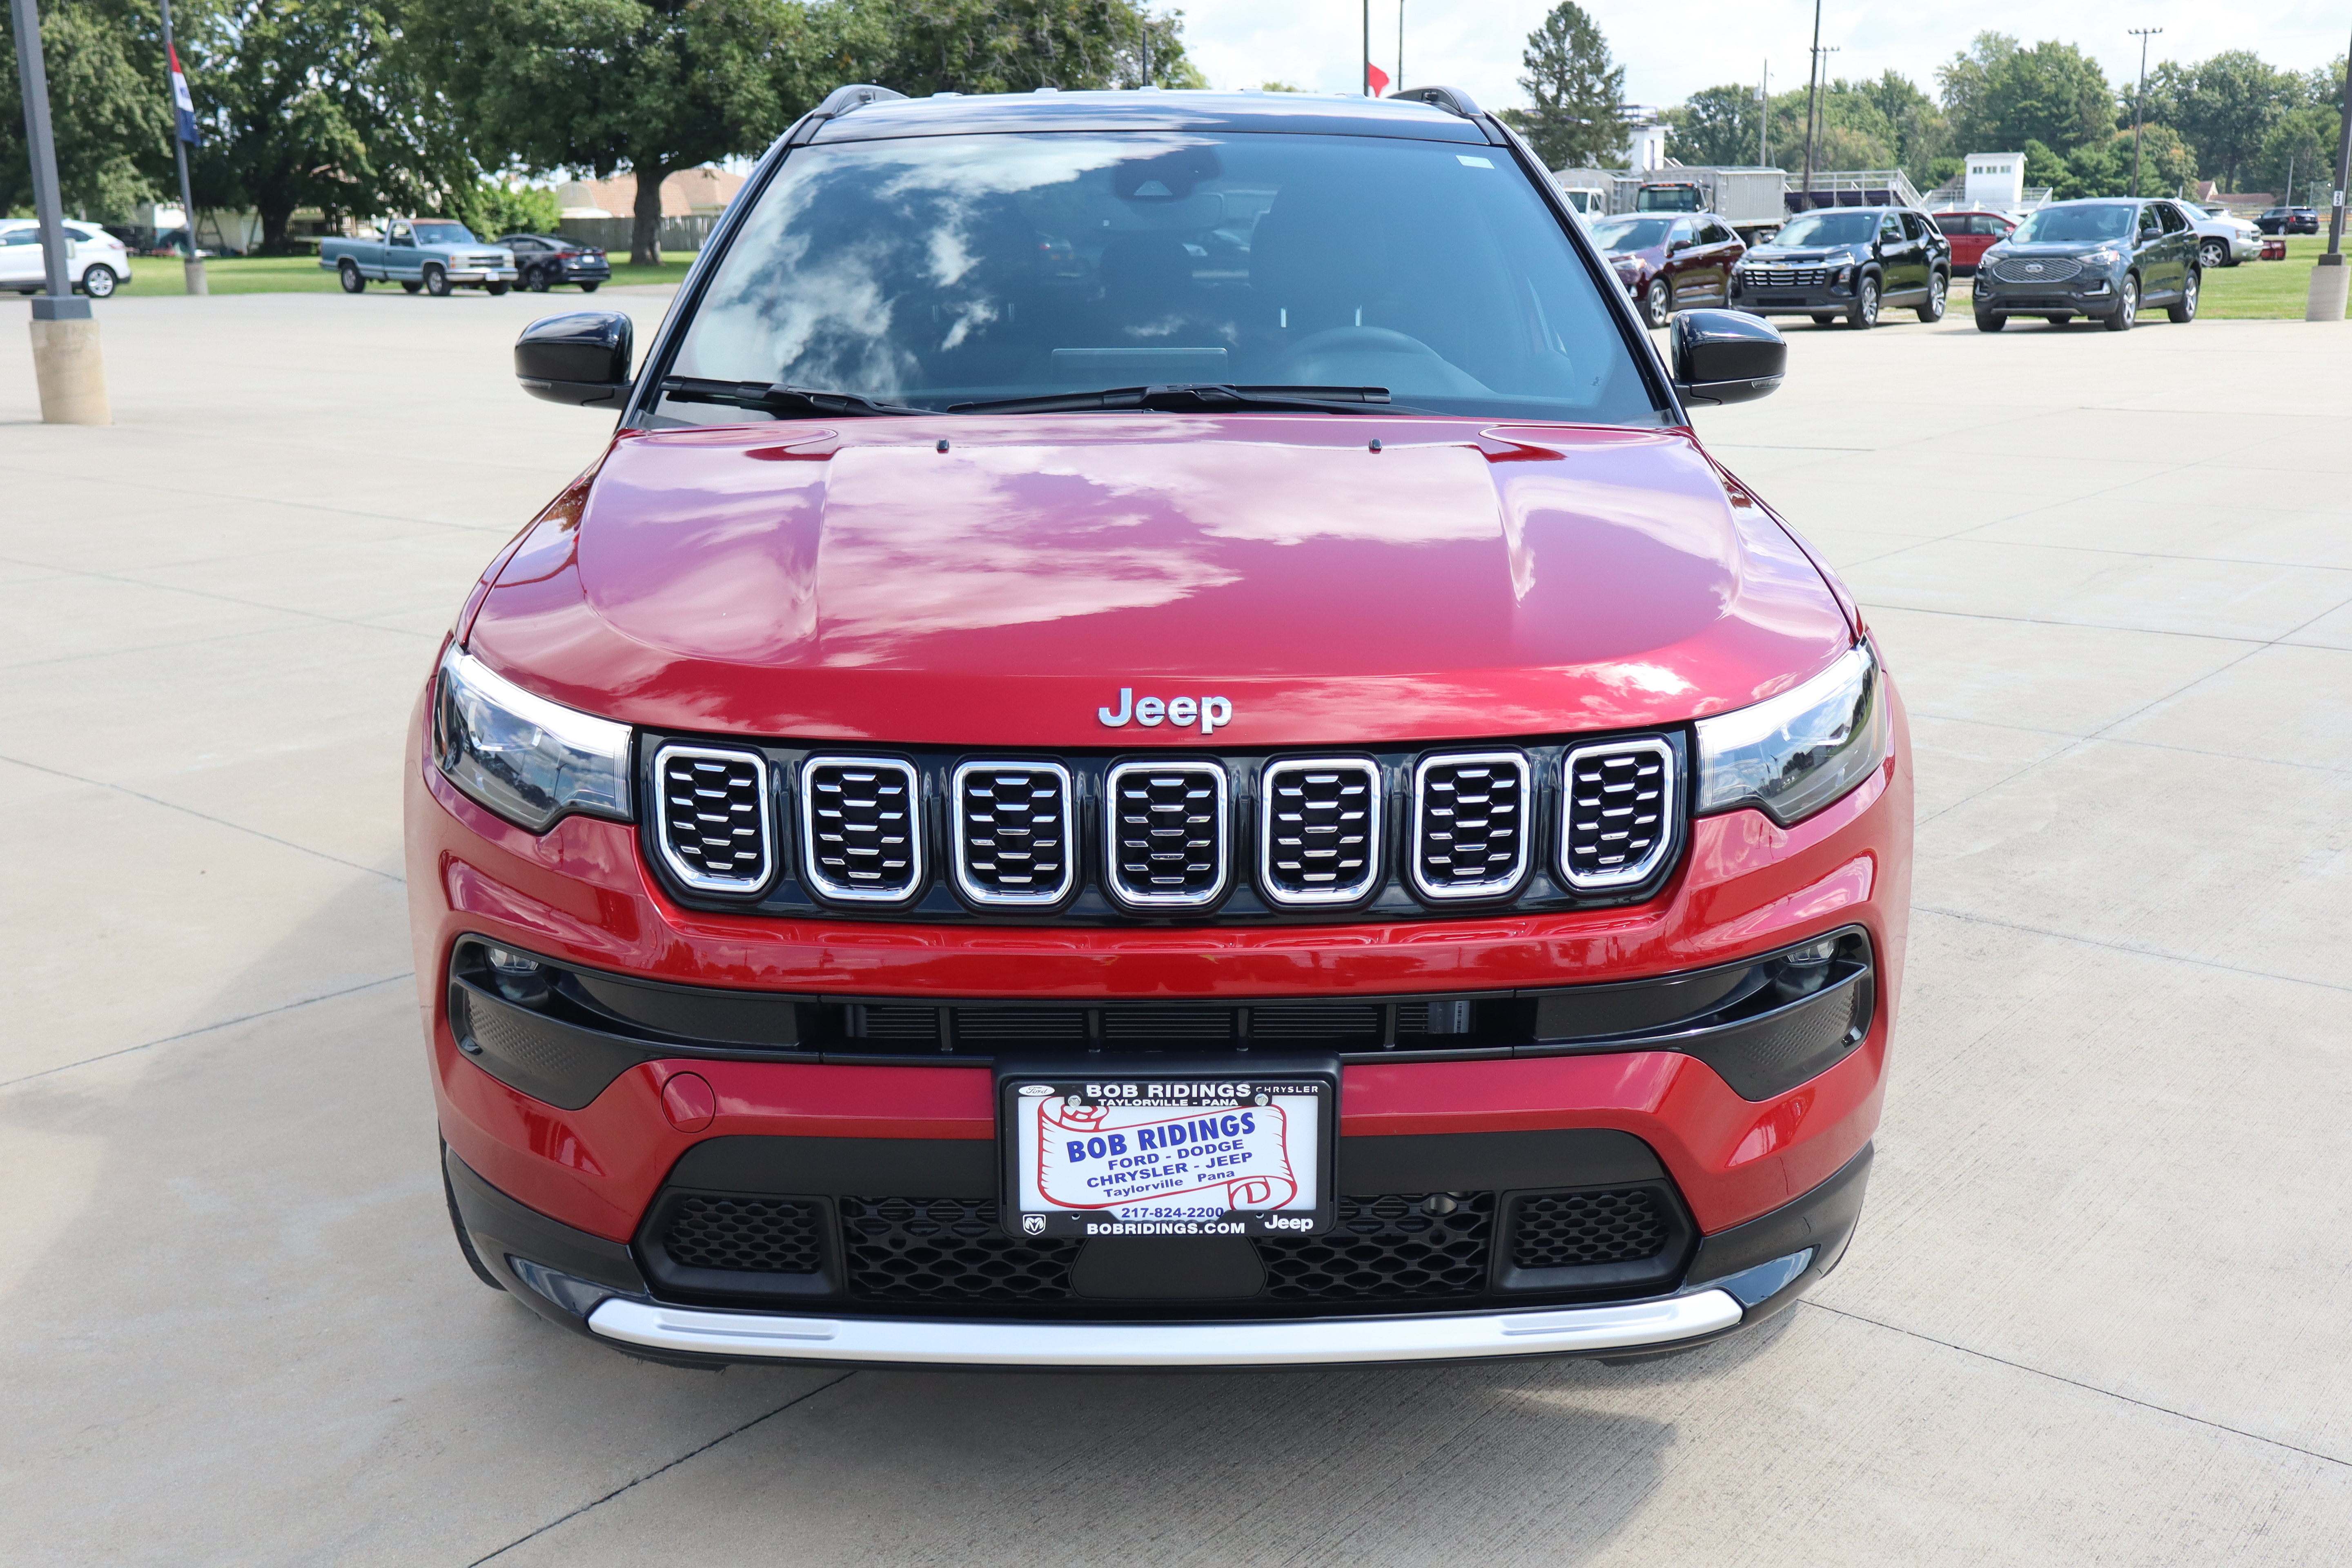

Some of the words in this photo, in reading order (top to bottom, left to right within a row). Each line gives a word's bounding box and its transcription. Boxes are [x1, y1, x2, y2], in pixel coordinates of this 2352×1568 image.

[1098, 688, 1232, 734] Jeep
[1087, 1084, 1138, 1098] BOB
[1148, 1084, 1251, 1098] RIDINGS
[1066, 1134, 1127, 1163] BOB
[1137, 1112, 1256, 1151] RIDINGS
[1108, 1153, 1160, 1171] FORD
[1177, 1139, 1244, 1159] DODGE
[1087, 1163, 1189, 1188] CHRYSLER
[1205, 1152, 1253, 1168] JEEP
[1103, 1178, 1183, 1198] Taylorville
[1197, 1170, 1235, 1182] Pana
[1121, 1207, 1224, 1218] 217-824-2200
[1264, 1214, 1314, 1232] Jeep
[1087, 1223, 1245, 1234] BOBRIDINGS.COM
